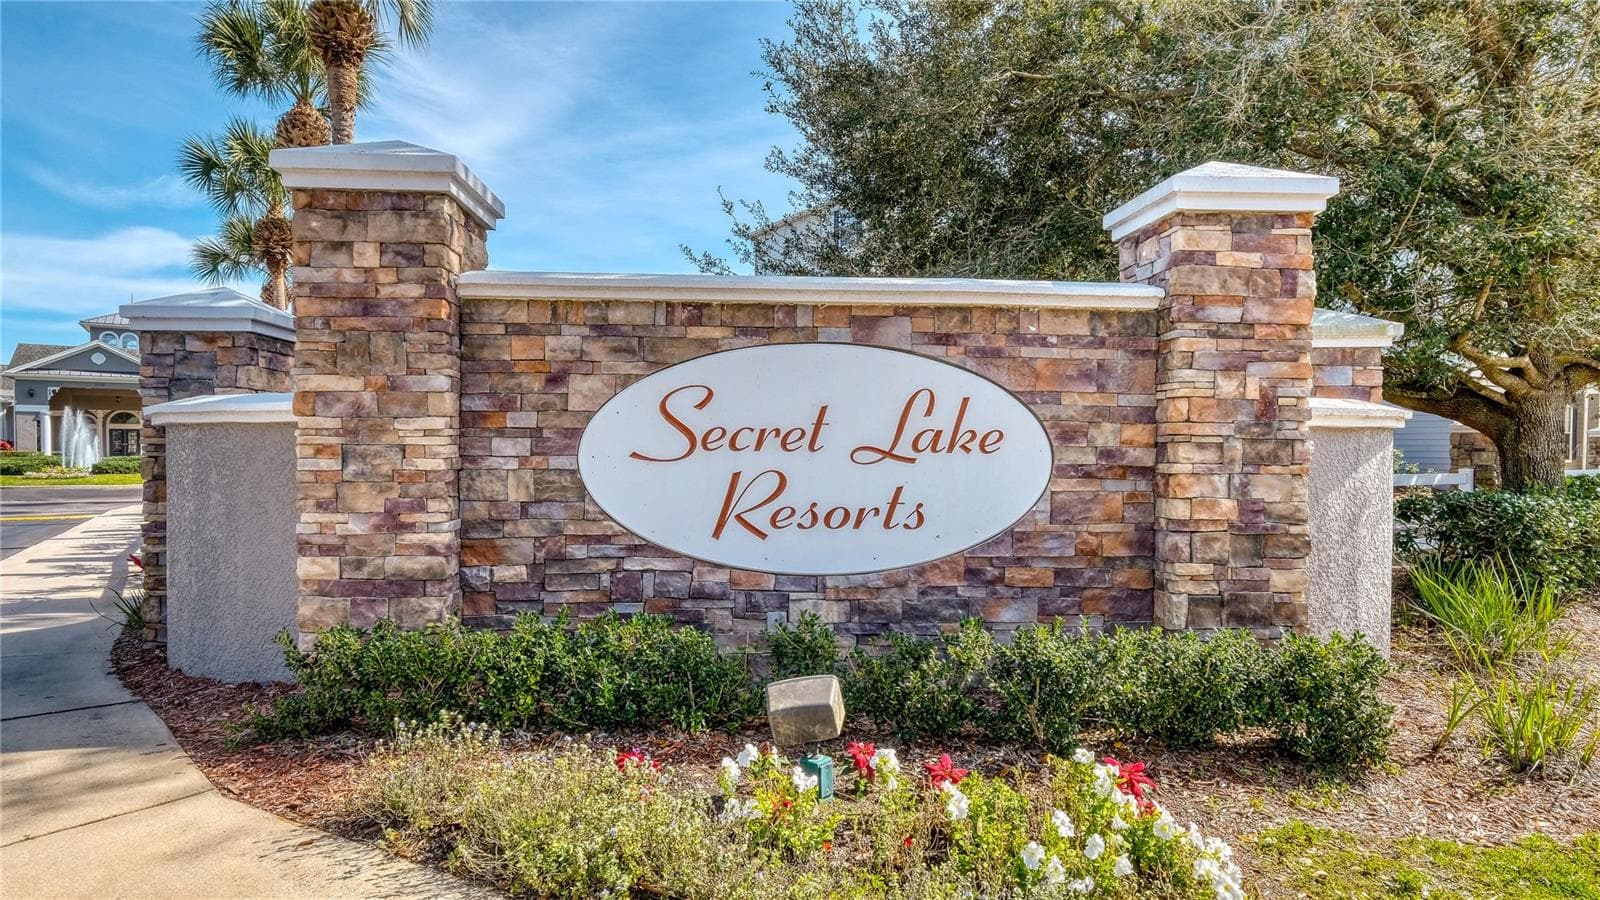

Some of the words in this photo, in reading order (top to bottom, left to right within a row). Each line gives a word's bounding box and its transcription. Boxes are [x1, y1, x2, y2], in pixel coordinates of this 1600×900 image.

[629, 384, 830, 463] Secret
[849, 387, 1005, 465] Lake
[711, 469, 926, 541] Resorts
